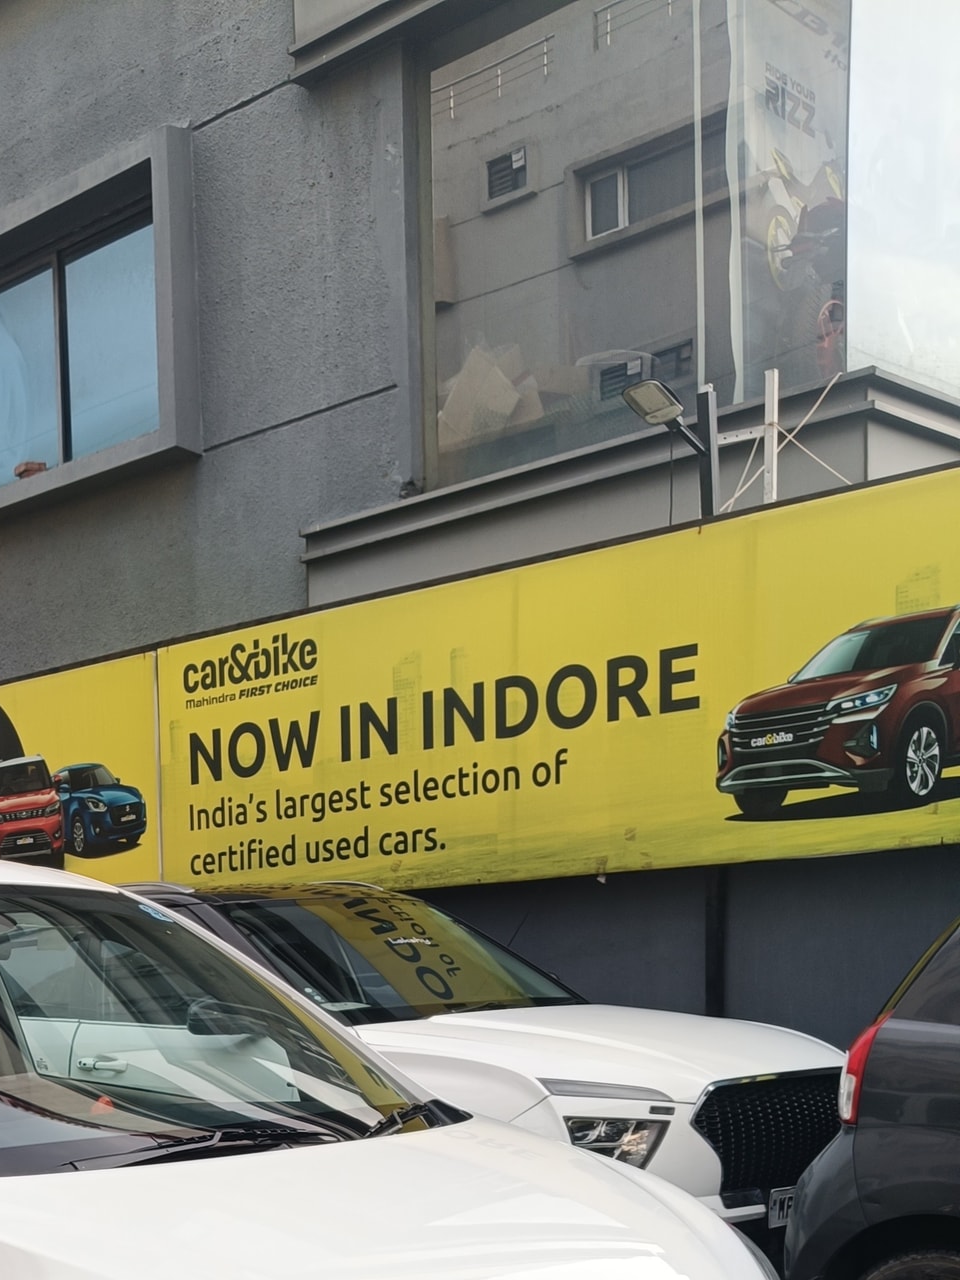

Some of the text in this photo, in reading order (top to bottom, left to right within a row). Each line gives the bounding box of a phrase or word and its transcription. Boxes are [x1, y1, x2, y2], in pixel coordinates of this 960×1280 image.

[764, 75, 816, 138] RIZZ
[789, 78, 816, 104] YOUR
[183, 632, 318, 694] car&bike
[185, 674, 319, 710] Mahindra FIRST CHOICE
[189, 642, 700, 785] NOW IN INDORE
[750, 731, 794, 748] car&bike
[189, 748, 569, 831] India's largest selection of
[190, 825, 447, 876] certified used cars.
